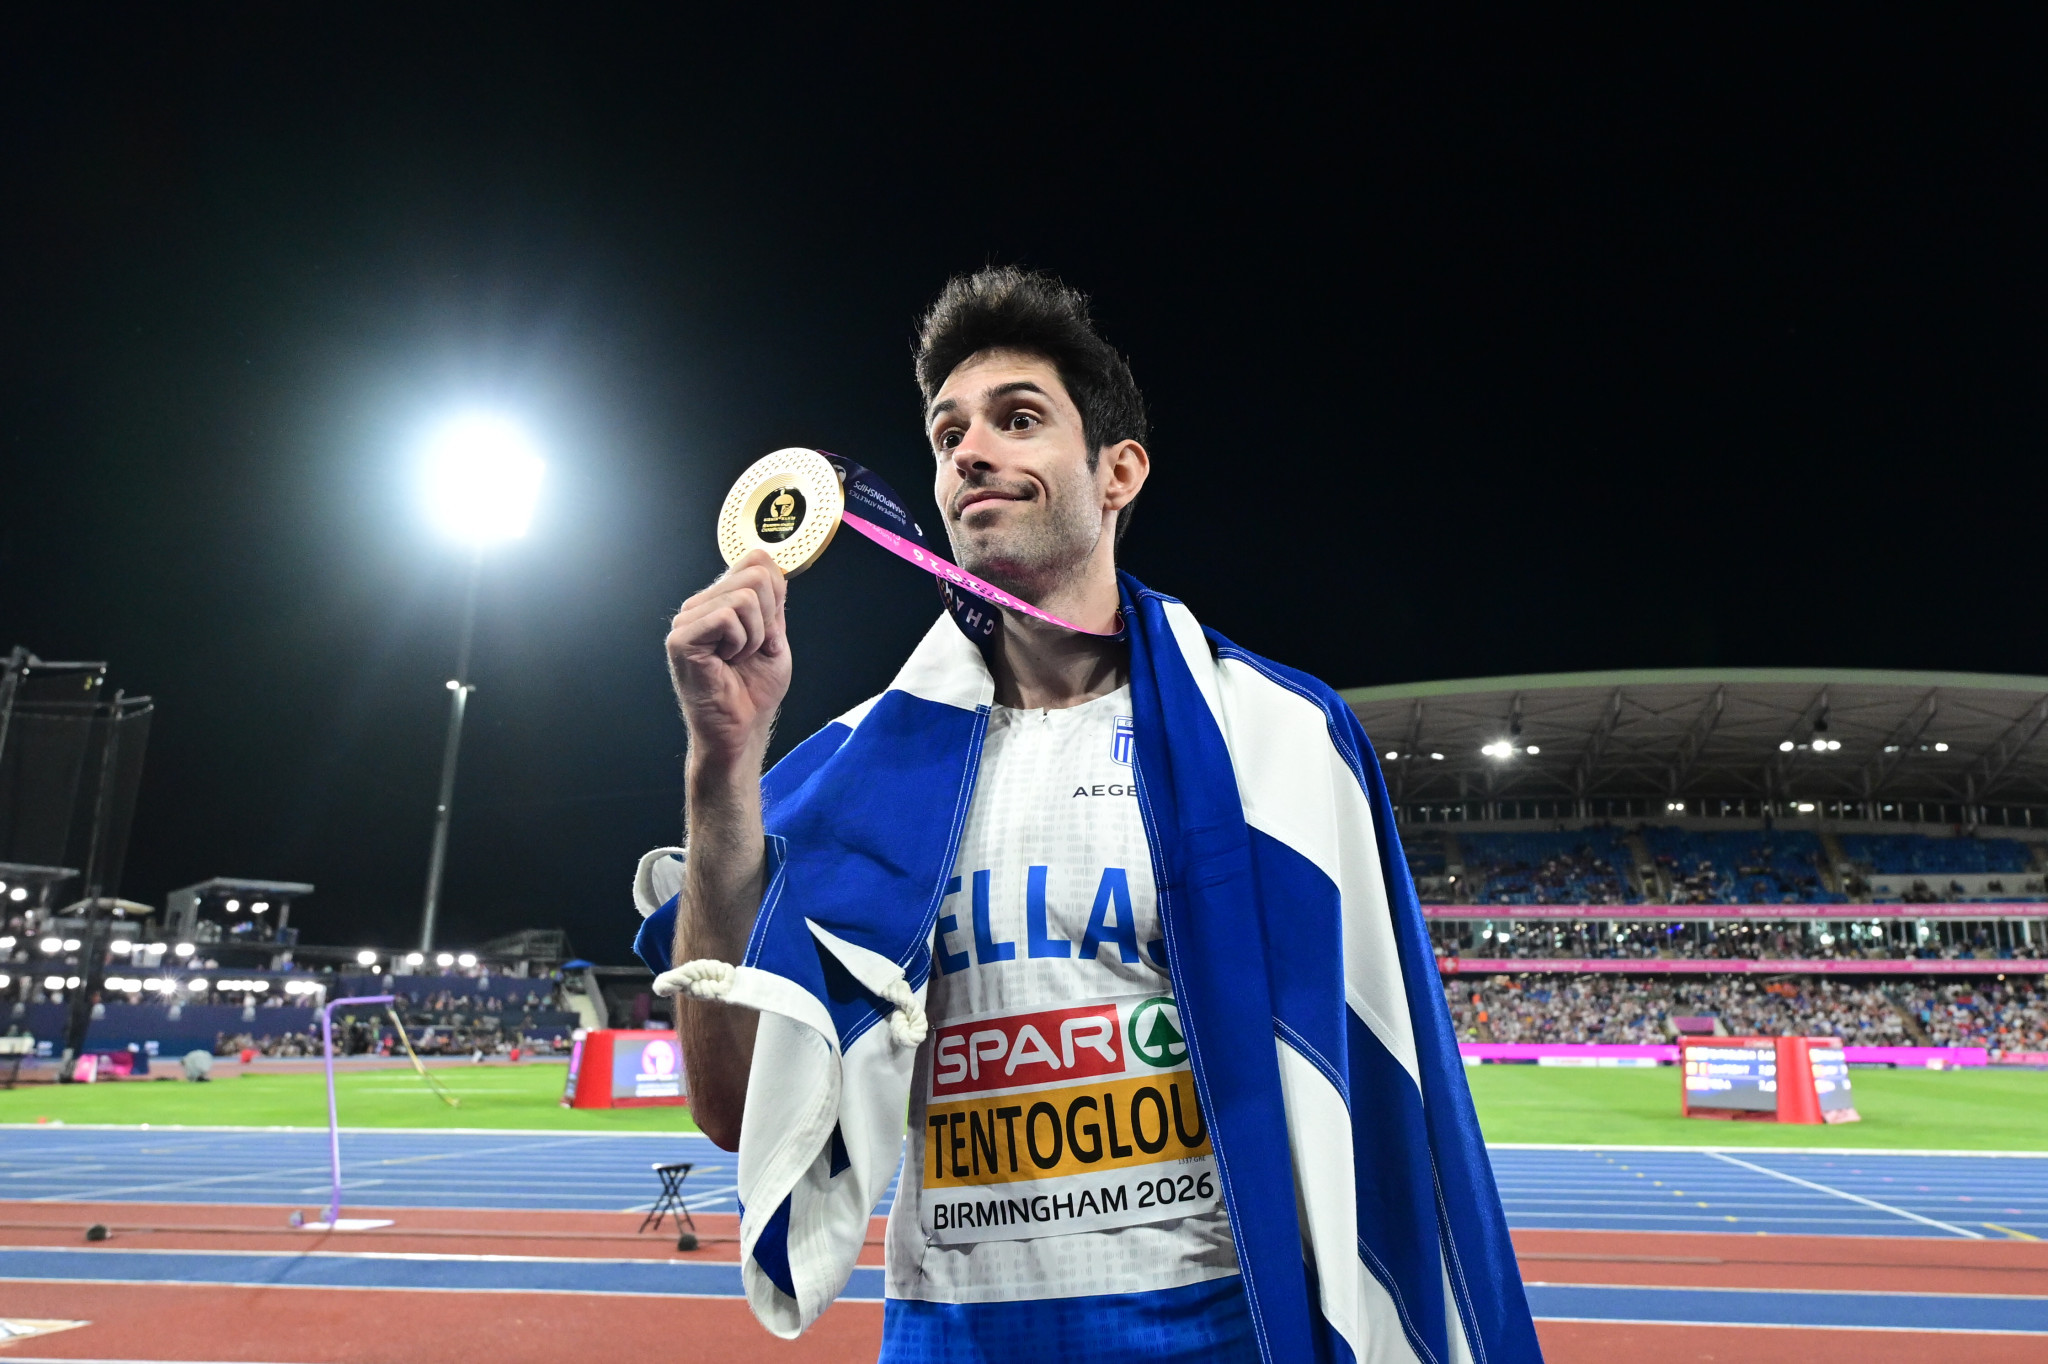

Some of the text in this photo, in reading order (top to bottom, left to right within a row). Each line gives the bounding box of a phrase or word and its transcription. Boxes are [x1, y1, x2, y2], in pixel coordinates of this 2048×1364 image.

[848, 489, 878, 508] ATHLETICS
[853, 480, 907, 518] CHAMPIONSHIPS
[1072, 784, 1138, 798] AEGE
[931, 865, 1168, 980] ELLA
[936, 1015, 1117, 1085] SPAR
[928, 1083, 1208, 1180] TENTOGLOU
[934, 1171, 1214, 1230] BIRMINGHAM 2026
